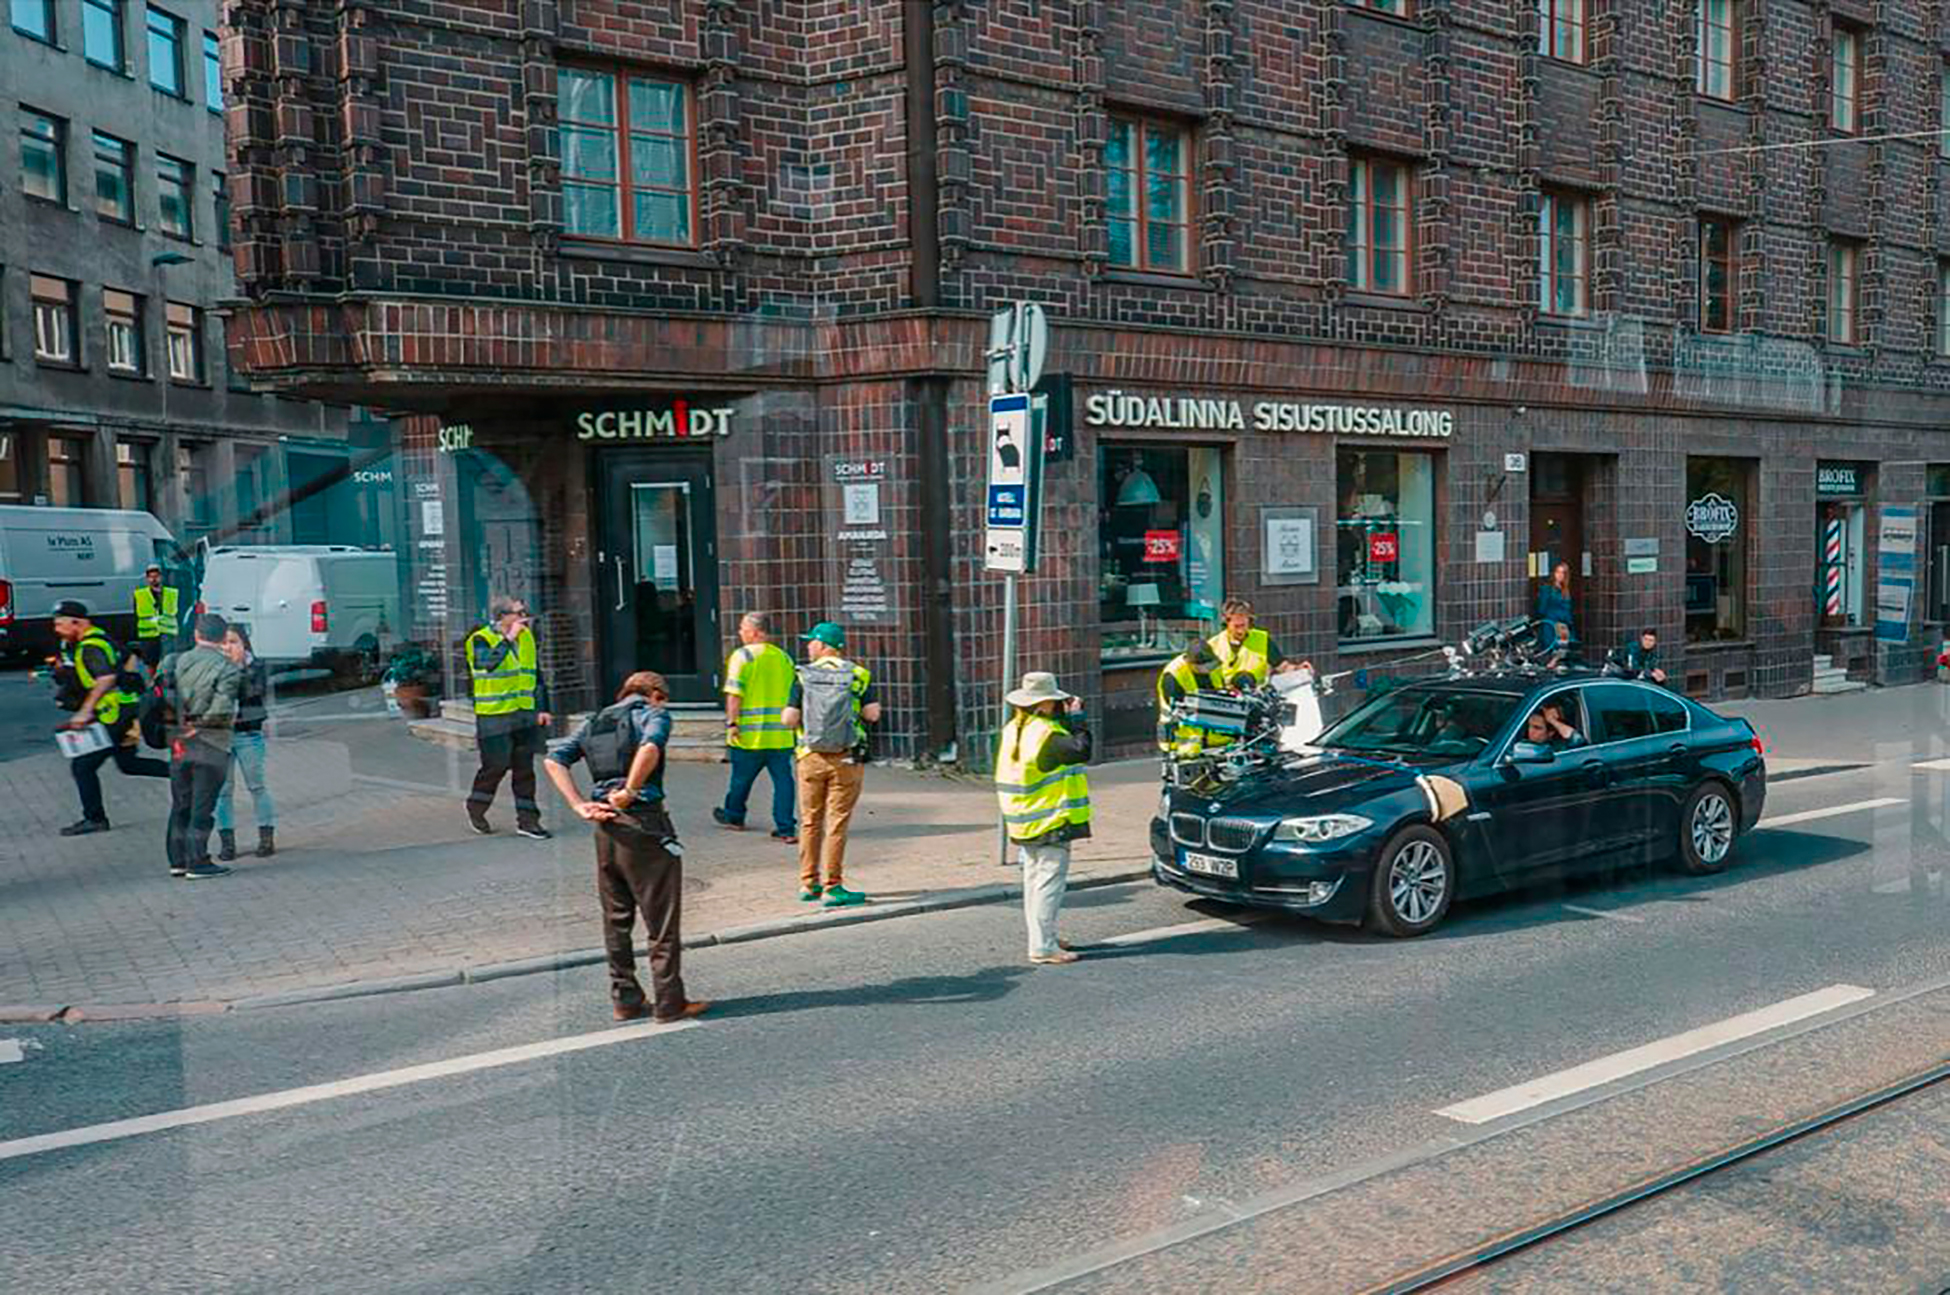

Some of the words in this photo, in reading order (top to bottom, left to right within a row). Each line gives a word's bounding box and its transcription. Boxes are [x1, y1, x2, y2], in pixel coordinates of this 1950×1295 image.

[577, 399, 734, 439] SCHMIDT
[1085, 390, 1245, 430] SÜDALINNA
[1253, 402, 1453, 437] SISUSTUSSALONG
[835, 460, 885, 475] SCHMIDT
[1818, 468, 1855, 483] BROFIX
[1693, 506, 1730, 521] BROFIX
